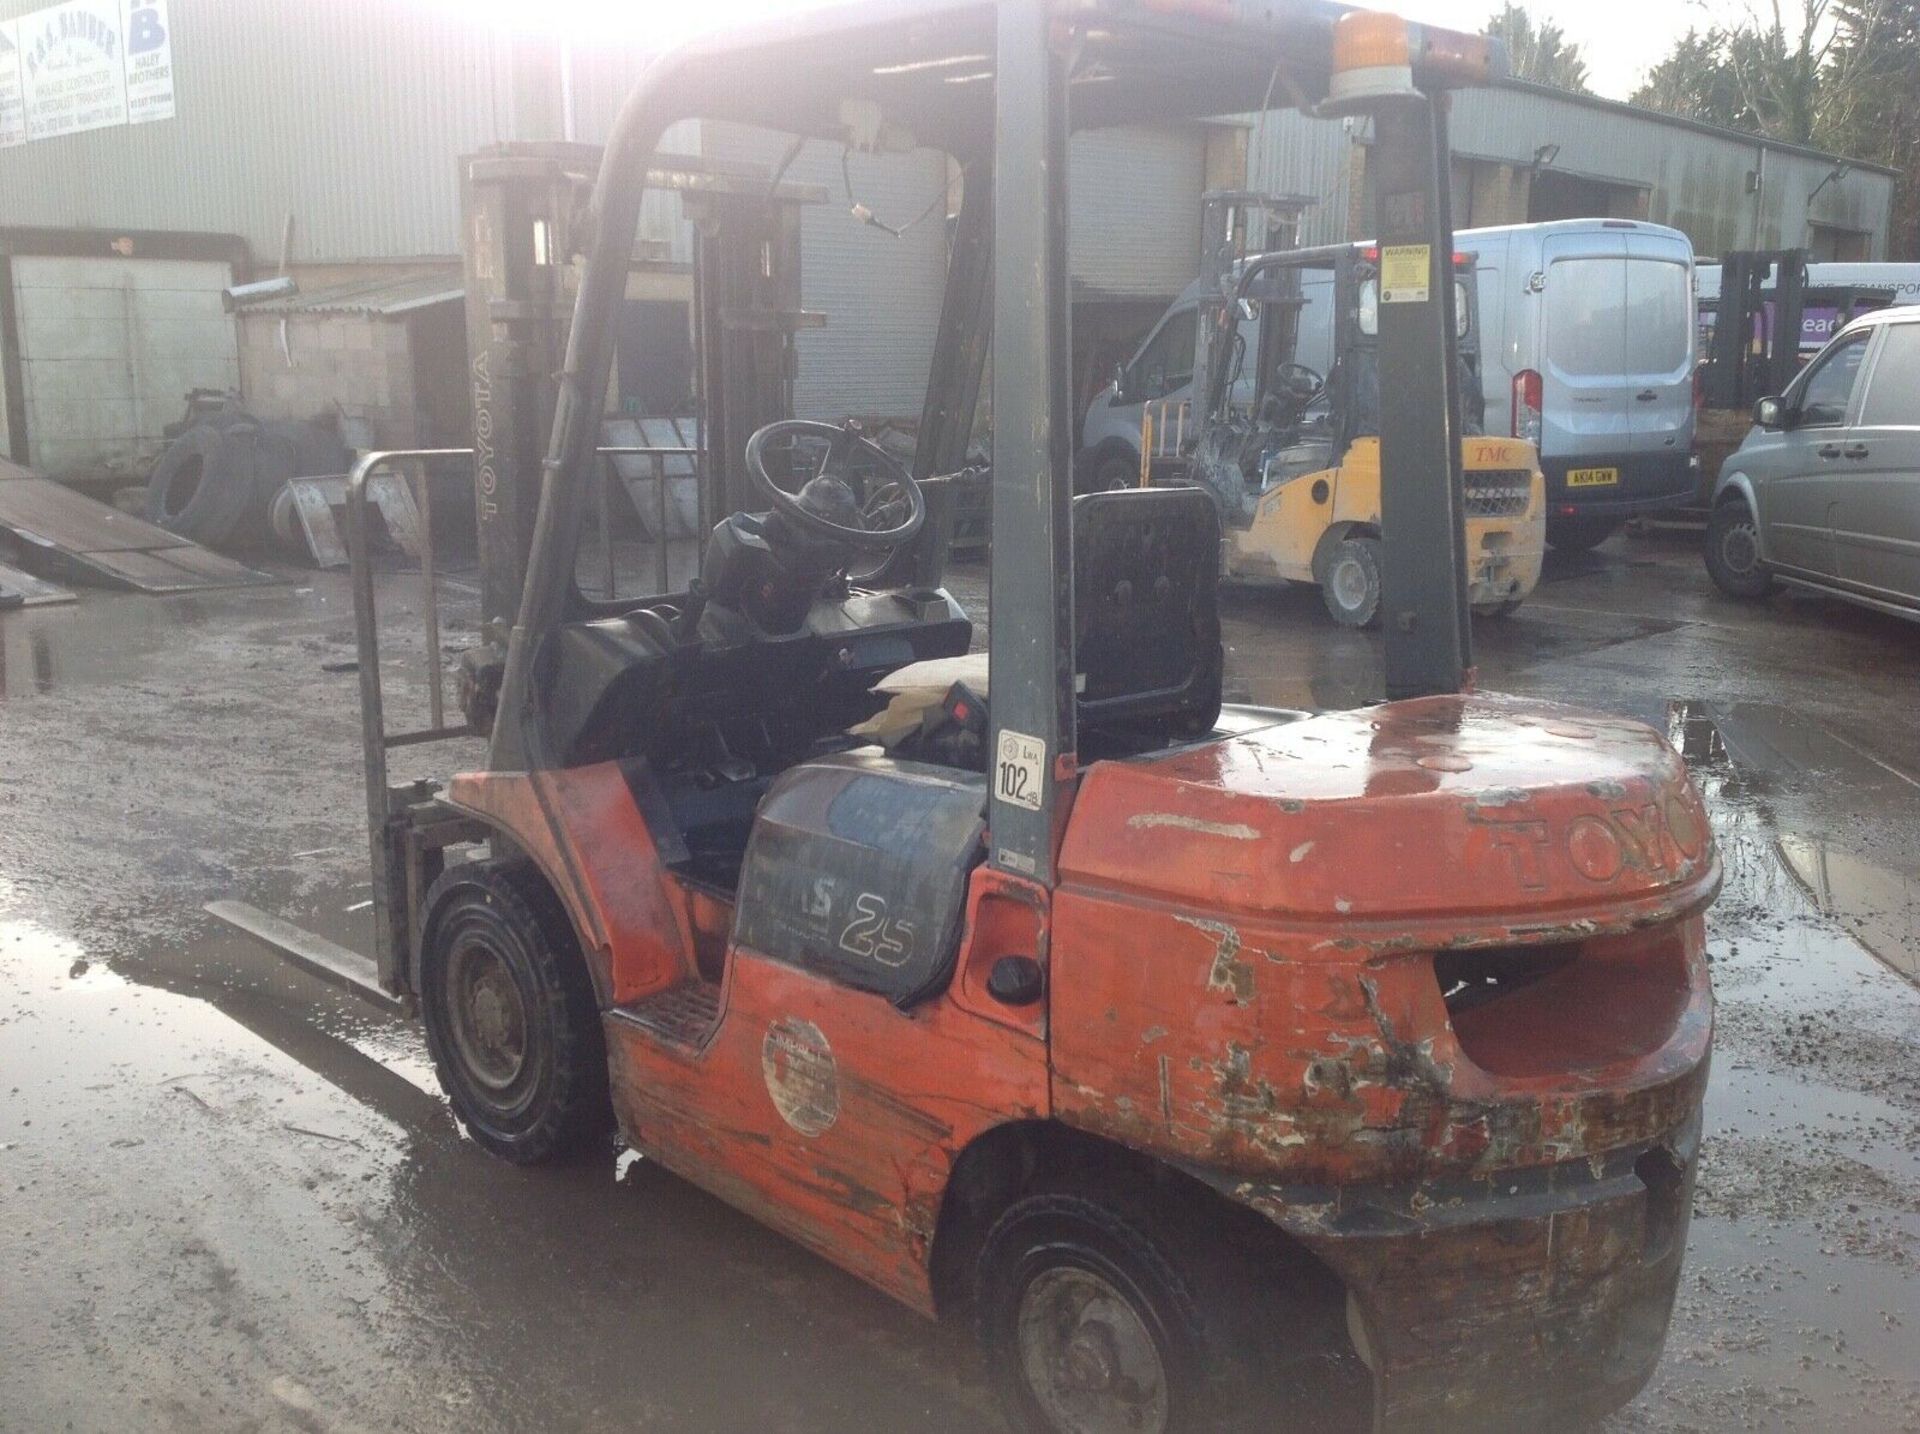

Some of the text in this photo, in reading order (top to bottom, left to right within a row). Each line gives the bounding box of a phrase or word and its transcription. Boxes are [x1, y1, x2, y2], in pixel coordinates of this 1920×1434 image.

[1384, 246, 1428, 257] WARNING
[473, 350, 497, 521] TOYOTA
[1475, 446, 1513, 462] TMC
[1000, 761, 1039, 804] 102 dB
[839, 892, 915, 968] 25
